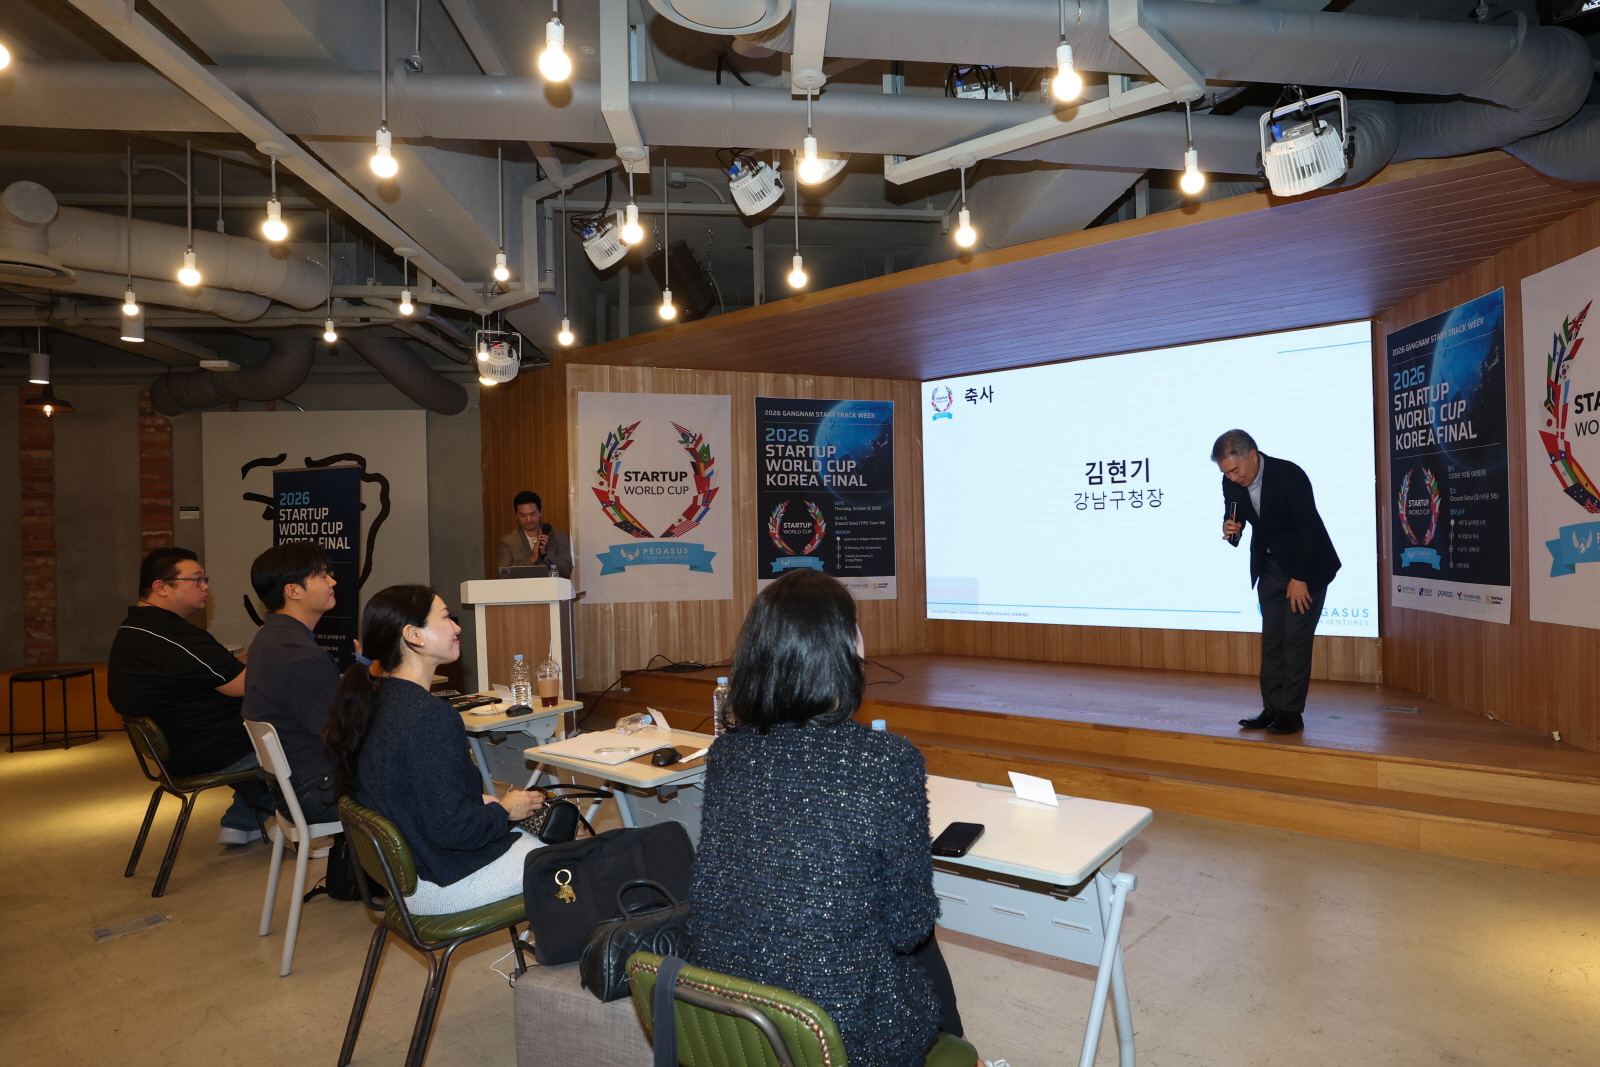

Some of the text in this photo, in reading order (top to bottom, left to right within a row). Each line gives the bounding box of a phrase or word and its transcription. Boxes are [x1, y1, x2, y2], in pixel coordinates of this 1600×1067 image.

[1392, 317, 1485, 356] 2026 GANGNAM START TRACK WEEK
[1393, 364, 1425, 391] 2026
[965, 385, 994, 405] 축사
[1394, 382, 1449, 411] STARTUP
[1395, 400, 1467, 431] WORLD CUP
[765, 428, 809, 442] 2026
[1395, 420, 1477, 450] KOREA FINAL
[765, 444, 837, 458] STARTUP
[765, 459, 857, 472] WORLD CUP
[1085, 457, 1149, 485] 김현기
[623, 471, 688, 482] STARTUP
[766, 473, 868, 487] KOREA FINAL
[623, 486, 689, 495] WORLD CUP
[279, 491, 310, 505] 2026
[1074, 488, 1164, 510] 강남구청장
[1408, 499, 1429, 507] STARTUP
[279, 507, 329, 521] STARTUP
[279, 521, 343, 535] WORLD CUP
[319, 537, 350, 550] FINAL
[1320, 608, 1369, 618] GASUS
